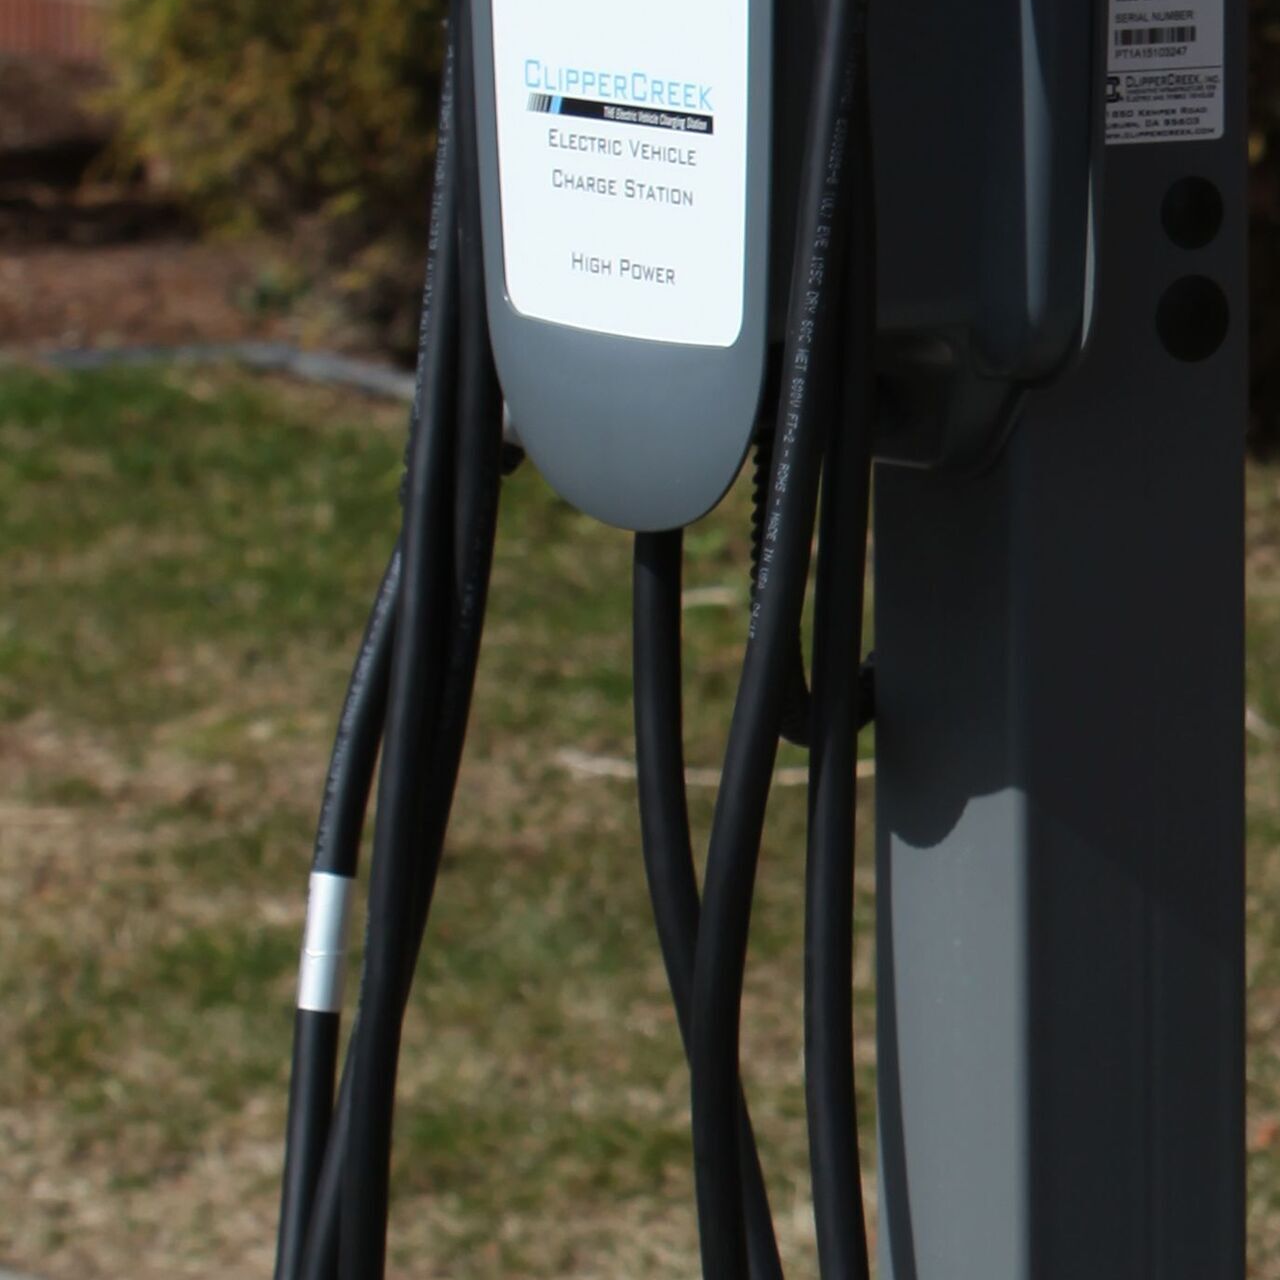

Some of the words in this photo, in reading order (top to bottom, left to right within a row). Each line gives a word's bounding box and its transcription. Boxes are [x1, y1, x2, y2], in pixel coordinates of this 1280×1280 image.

[1115, 12, 1149, 23] SERIAL
[524, 59, 713, 111] CLIPPERCREEK
[549, 128, 623, 156] ELECTRIC
[628, 139, 697, 166] VEHICLE
[552, 169, 617, 196] CHARGE
[624, 180, 693, 206] STATION
[571, 252, 611, 275] HIGH
[620, 259, 676, 285] POWER
[765, 511, 780, 541] MADE
[762, 546, 774, 563] IN
